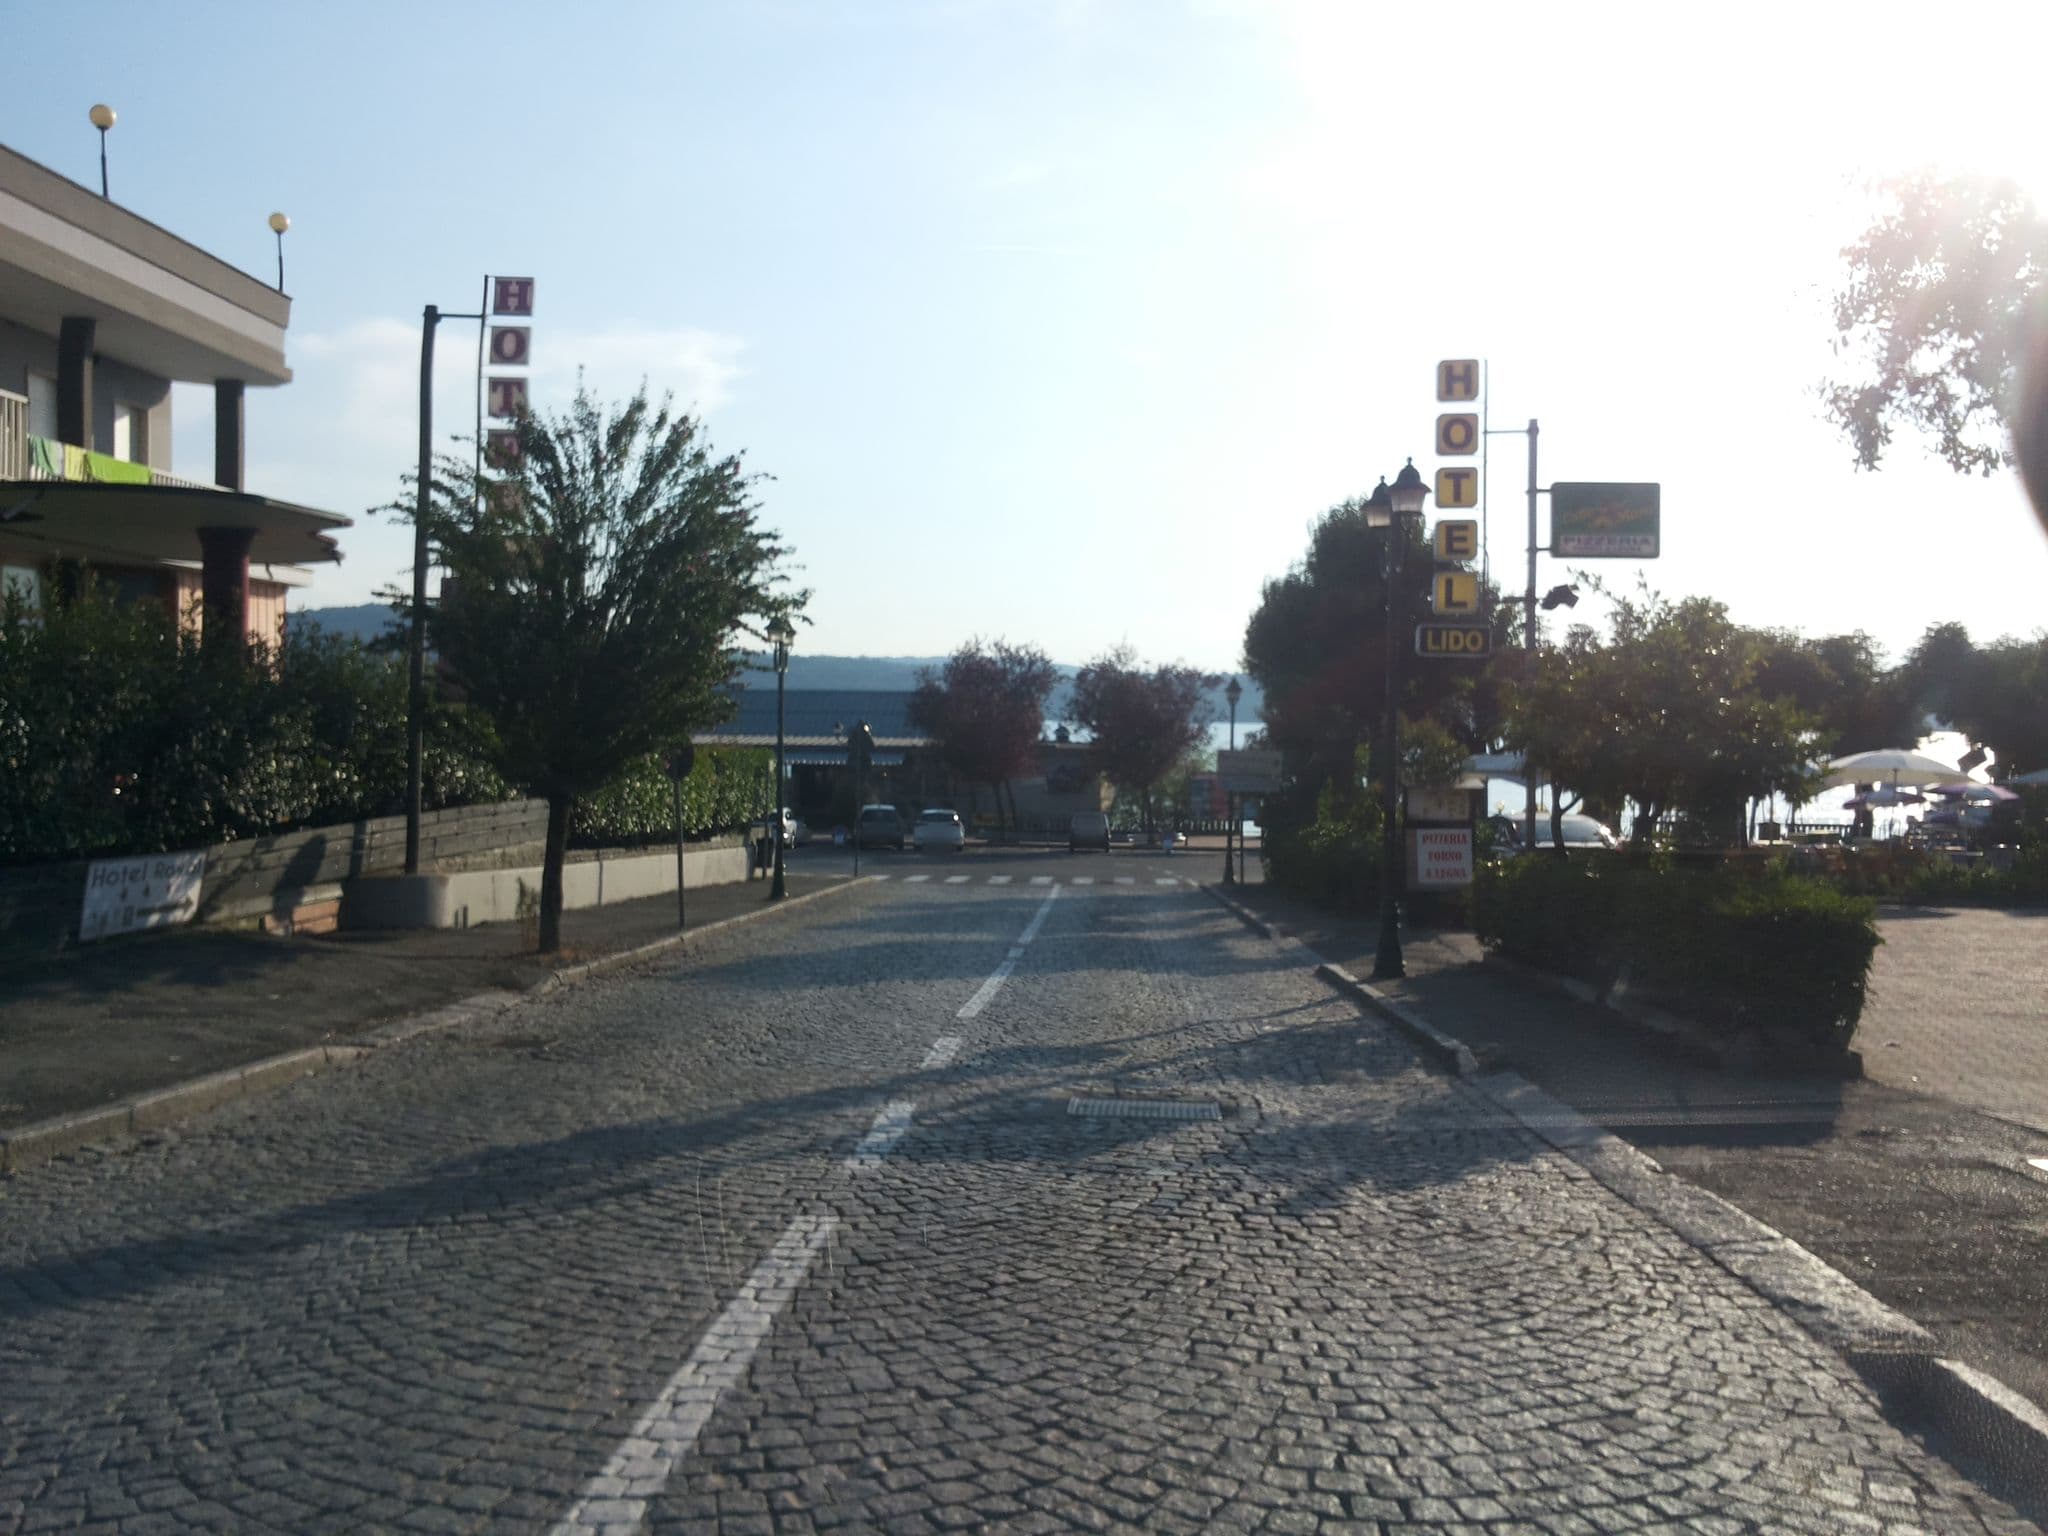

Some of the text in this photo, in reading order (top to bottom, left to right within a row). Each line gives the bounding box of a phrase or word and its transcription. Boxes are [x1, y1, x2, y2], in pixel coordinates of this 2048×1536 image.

[1442, 364, 1474, 608] HOTEL
[1426, 628, 1483, 652] LIDO
[1422, 832, 1468, 845] PIZZERIA
[91, 861, 148, 888] Hotel
